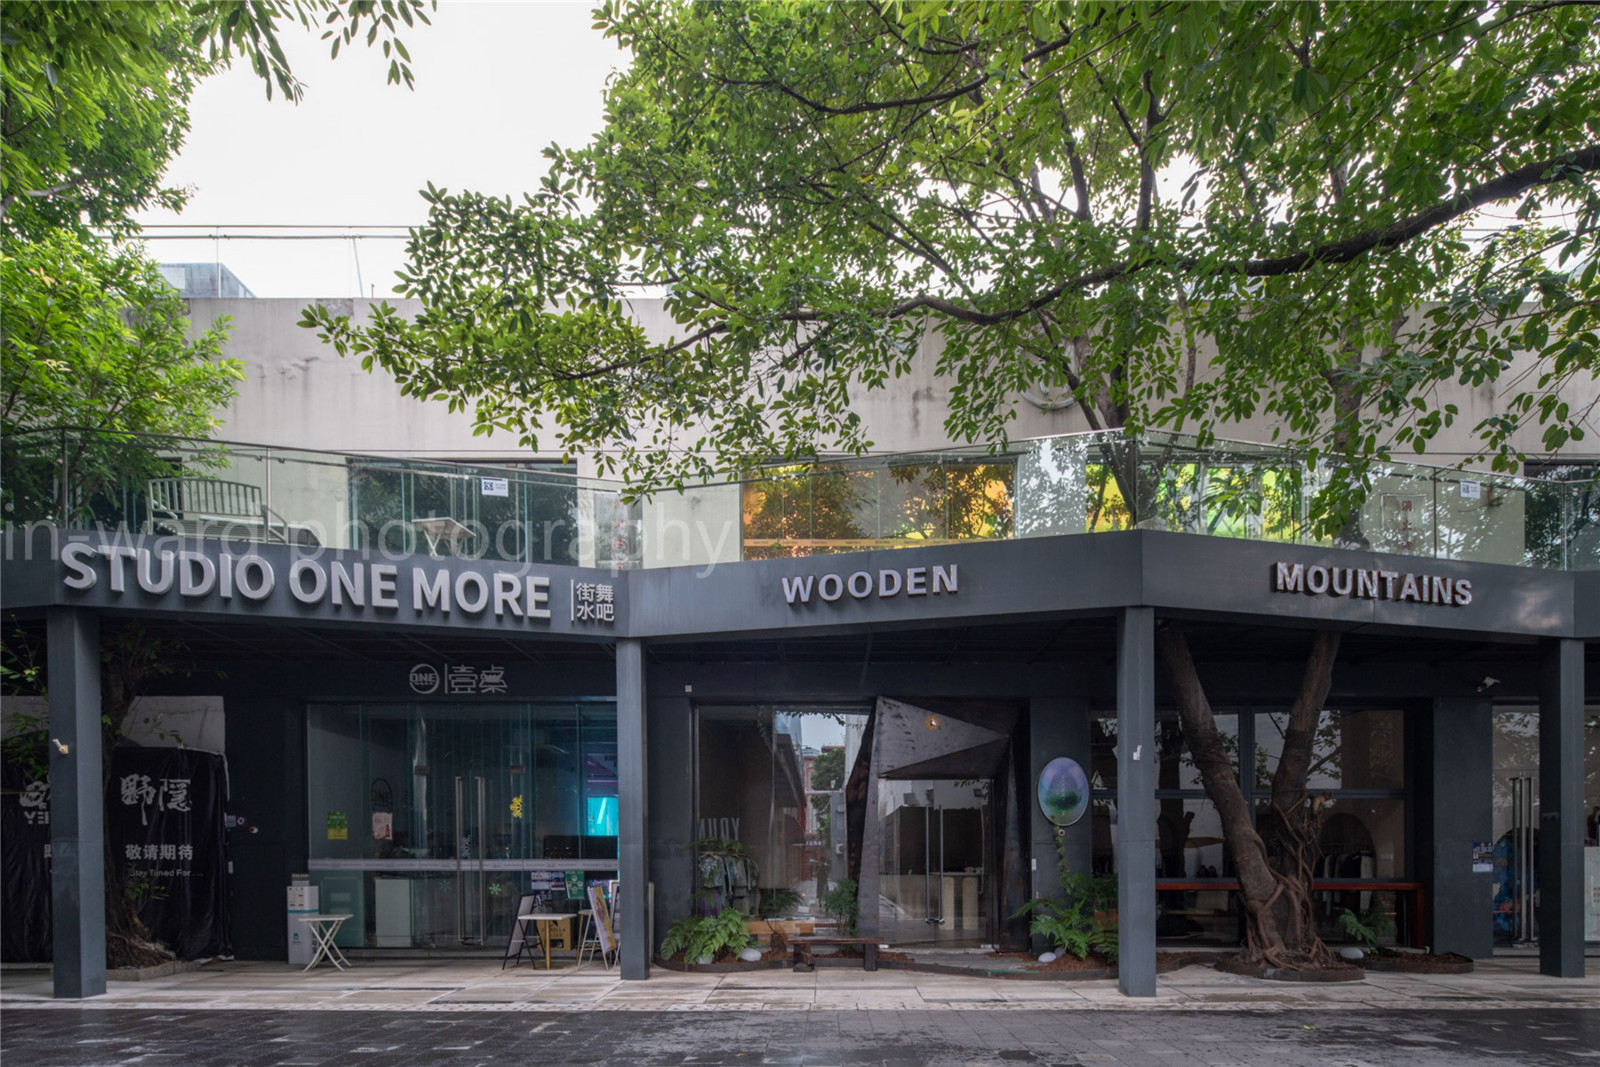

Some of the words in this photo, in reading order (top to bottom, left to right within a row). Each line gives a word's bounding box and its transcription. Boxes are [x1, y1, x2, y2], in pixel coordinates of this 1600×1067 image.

[61, 542, 275, 601] STUDIO
[289, 558, 399, 610] ONE
[412, 567, 551, 620] MORE
[576, 583, 614, 602] 街舞
[781, 564, 958, 604] WOODEN
[1274, 561, 1473, 606] MOUNTAINS
[576, 603, 615, 622] 水吧
[125, 844, 193, 861] 敬请期待
